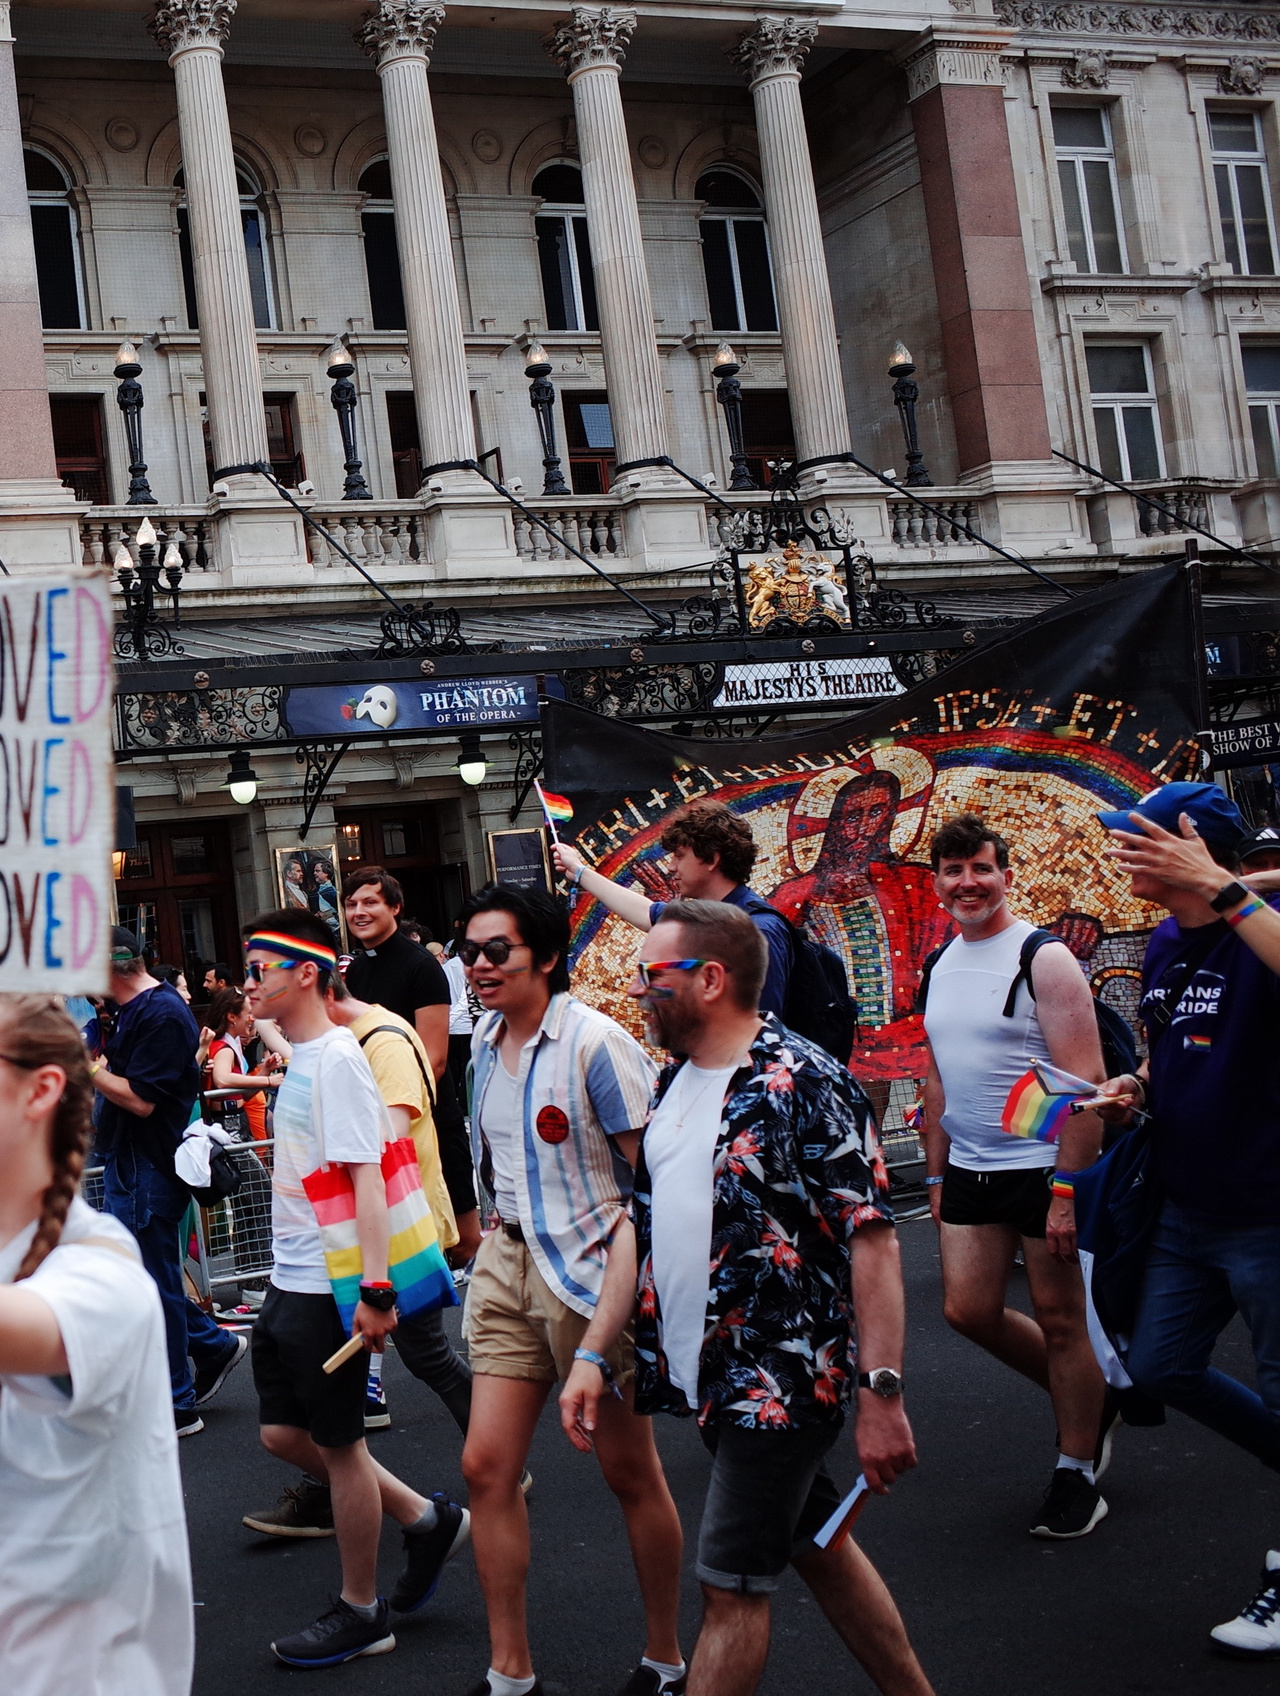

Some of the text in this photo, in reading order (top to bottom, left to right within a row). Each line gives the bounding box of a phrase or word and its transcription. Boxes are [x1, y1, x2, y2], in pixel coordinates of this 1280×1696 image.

[790, 663, 827, 677] HIS
[823, 671, 897, 696] THEATRE
[419, 686, 528, 711] PHANTOM
[436, 710, 516, 724] OF THE OPERA
[1211, 729, 1237, 744] THE
[1238, 723, 1271, 740] BEST
[1213, 739, 1252, 755] SHOW
[1255, 736, 1273, 750] OF
[1175, 1001, 1218, 1014] RIDE
